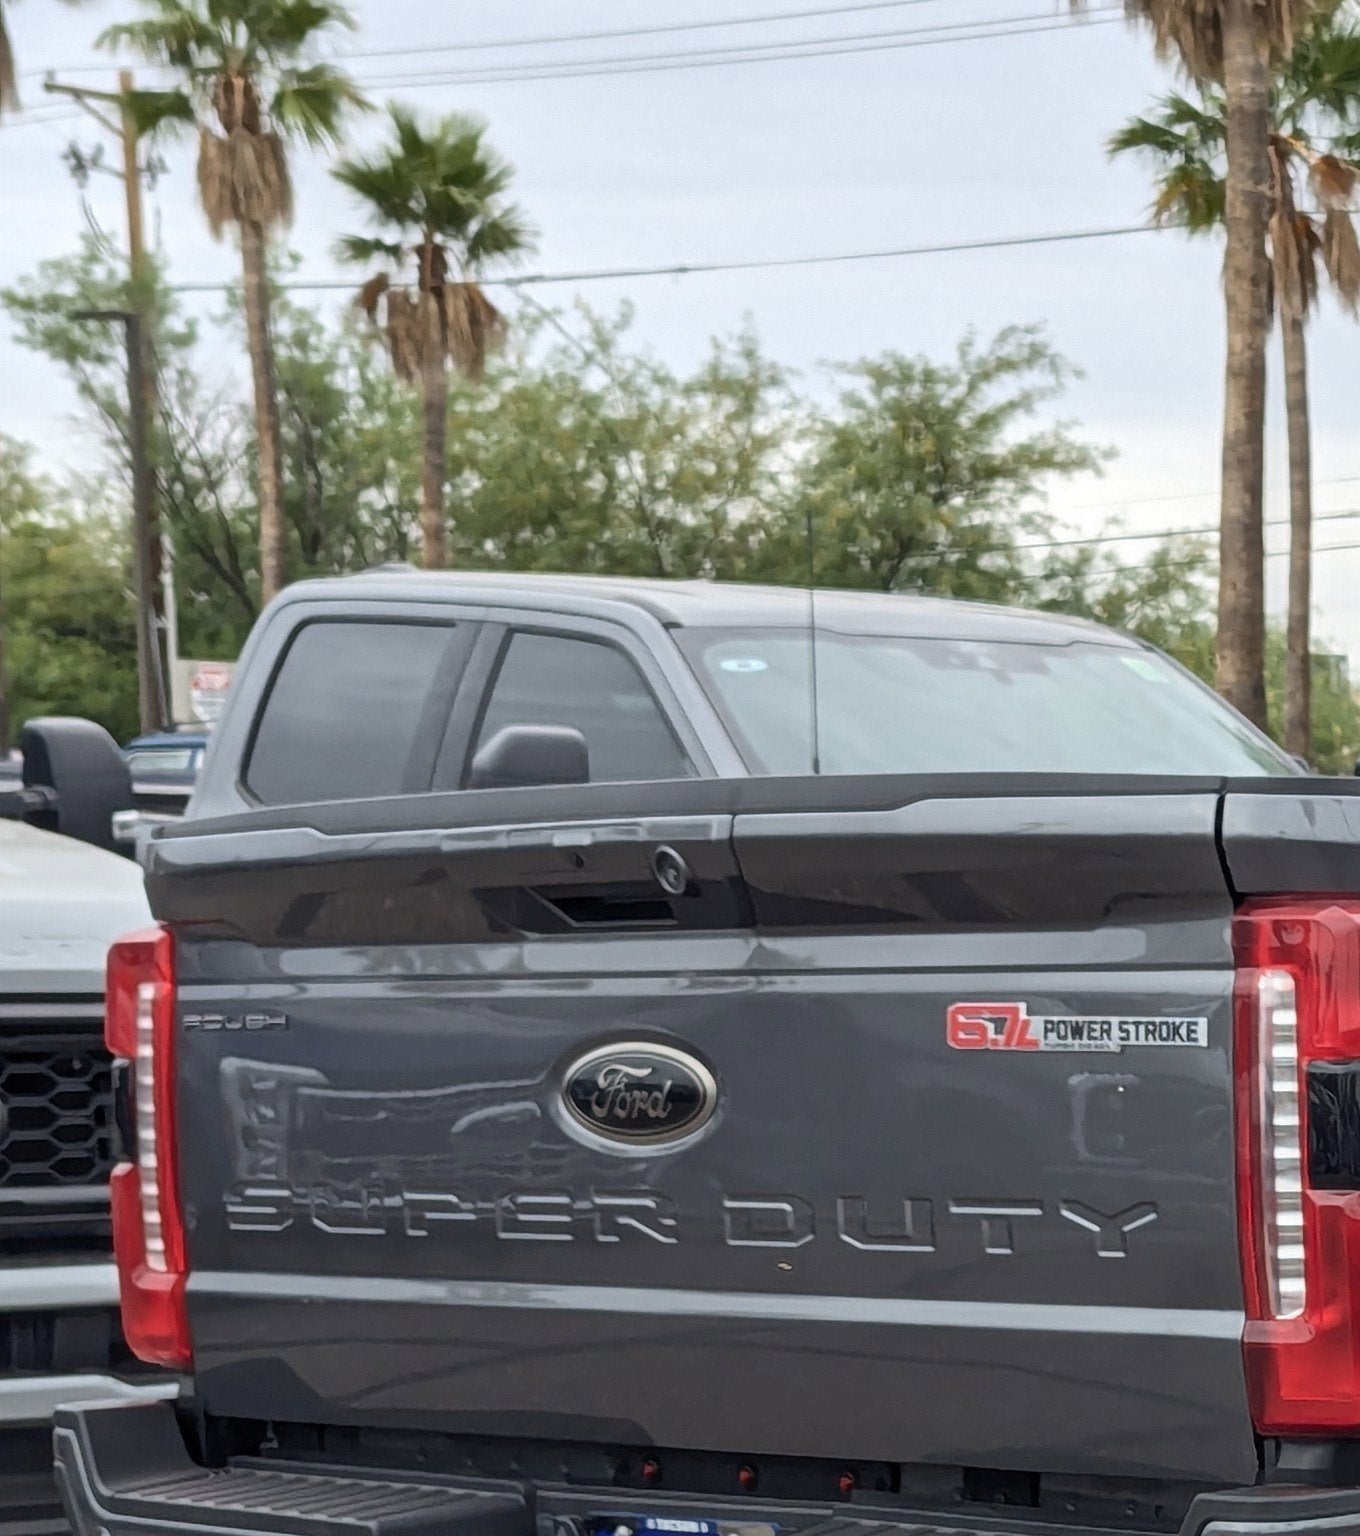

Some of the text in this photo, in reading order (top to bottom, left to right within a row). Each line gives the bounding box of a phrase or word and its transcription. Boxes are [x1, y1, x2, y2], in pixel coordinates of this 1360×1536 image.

[1043, 1019, 1113, 1042] POWER
[1118, 1020, 1199, 1043] STROKE
[590, 1063, 673, 1119] Ford
[222, 1179, 1159, 1258] SUPER DUTY
